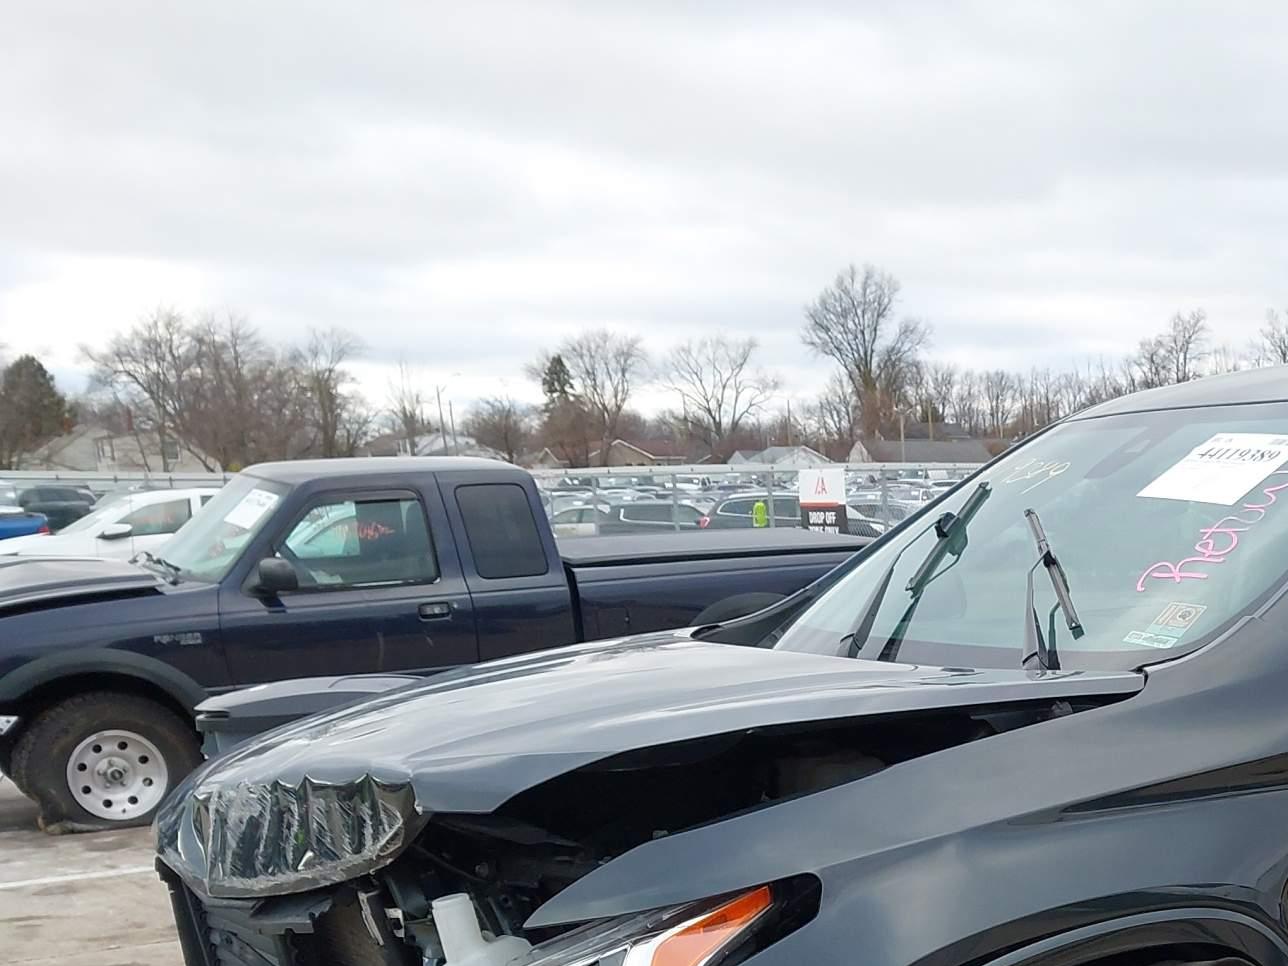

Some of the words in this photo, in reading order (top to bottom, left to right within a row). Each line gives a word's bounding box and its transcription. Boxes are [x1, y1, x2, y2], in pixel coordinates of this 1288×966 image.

[1196, 447, 1281, 462] 44119389
[808, 511, 825, 524] DROP
[825, 511, 836, 524] OFF
